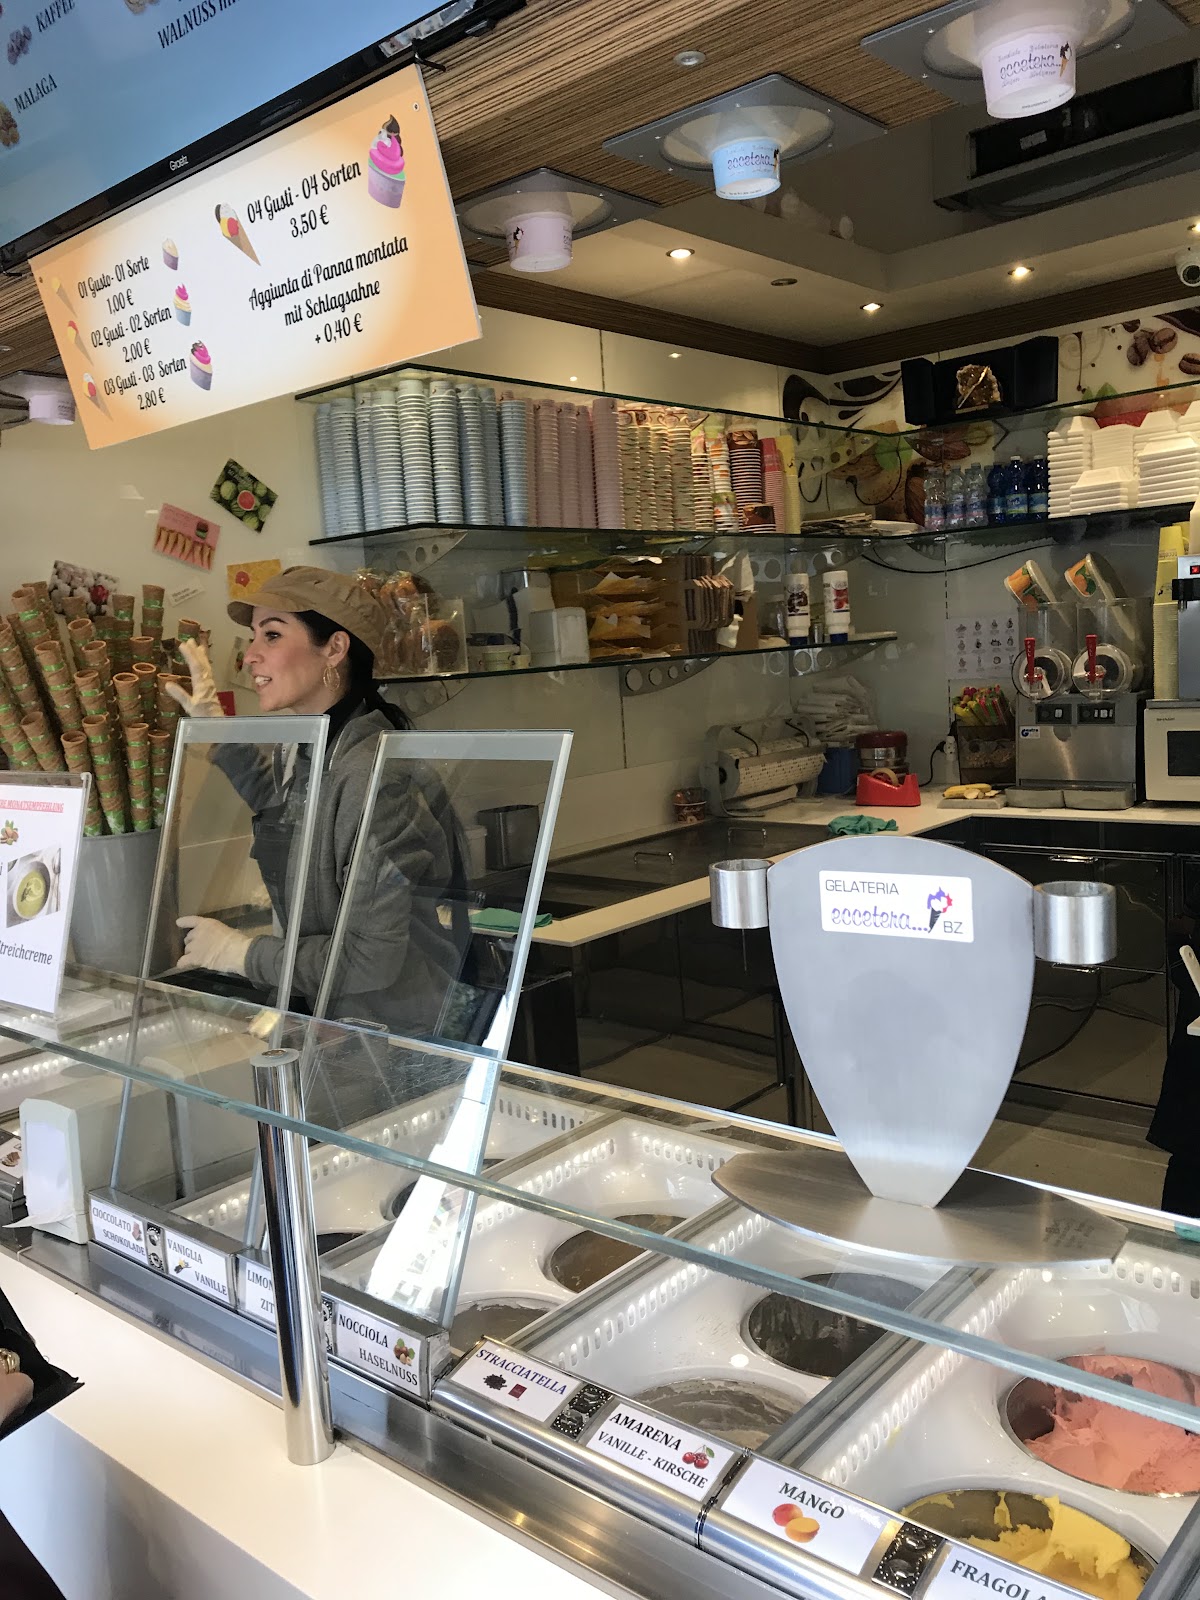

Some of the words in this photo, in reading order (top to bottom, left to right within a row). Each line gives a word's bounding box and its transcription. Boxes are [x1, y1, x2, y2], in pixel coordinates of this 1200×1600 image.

[157, 0, 216, 48] WALNUSS
[14, 73, 58, 114] MALAGA
[247, 200, 263, 224] 04
[264, 187, 294, 220] Gusti
[302, 174, 318, 199] 04
[321, 162, 361, 192] Sorten
[290, 210, 317, 238] 3,50
[320, 204, 329, 226] €
[77, 279, 88, 299] 01
[115, 264, 126, 282] 01
[127, 255, 150, 278] Sorte
[249, 277, 300, 310] Aggiunta
[301, 268, 313, 289] di
[313, 257, 354, 284] Panna
[355, 236, 408, 270] montata
[106, 292, 126, 315] 1,00
[127, 288, 134, 306] €
[284, 304, 303, 326] mit
[305, 281, 381, 319] Schlagsahne
[90, 330, 103, 349] 02
[103, 322, 125, 347] Gusti
[130, 314, 143, 333] 02
[144, 307, 172, 328] Sorten
[315, 334, 321, 344] +
[324, 317, 351, 343] 0,40
[354, 313, 363, 333] €
[122, 342, 143, 363] 2,00
[144, 338, 152, 355] €
[104, 378, 116, 396] 03
[116, 371, 138, 396] Gusti
[142, 364, 155, 382] 03
[158, 358, 187, 378] Sorten
[137, 392, 158, 410] 2,80
[159, 387, 166, 404] €
[825, 879, 899, 895] GELATERIA
[943, 920, 964, 934] BZ
[0, 940, 53, 966] treichcreme
[92, 1207, 131, 1233] CIOCCOLATO
[103, 1229, 146, 1256] SCHOKOLADE
[167, 1239, 203, 1265] VANIGLIA
[194, 1271, 227, 1296] VANILLE
[338, 1313, 389, 1348] NOCCIOLA
[359, 1347, 418, 1386] HASELNUSS
[475, 1348, 568, 1396] STRACCIATELLA
[609, 1412, 682, 1452] AMARENA
[597, 1431, 648, 1461] VANILLE
[653, 1456, 709, 1489] KIRSCHE
[778, 1481, 845, 1520] MANGO
